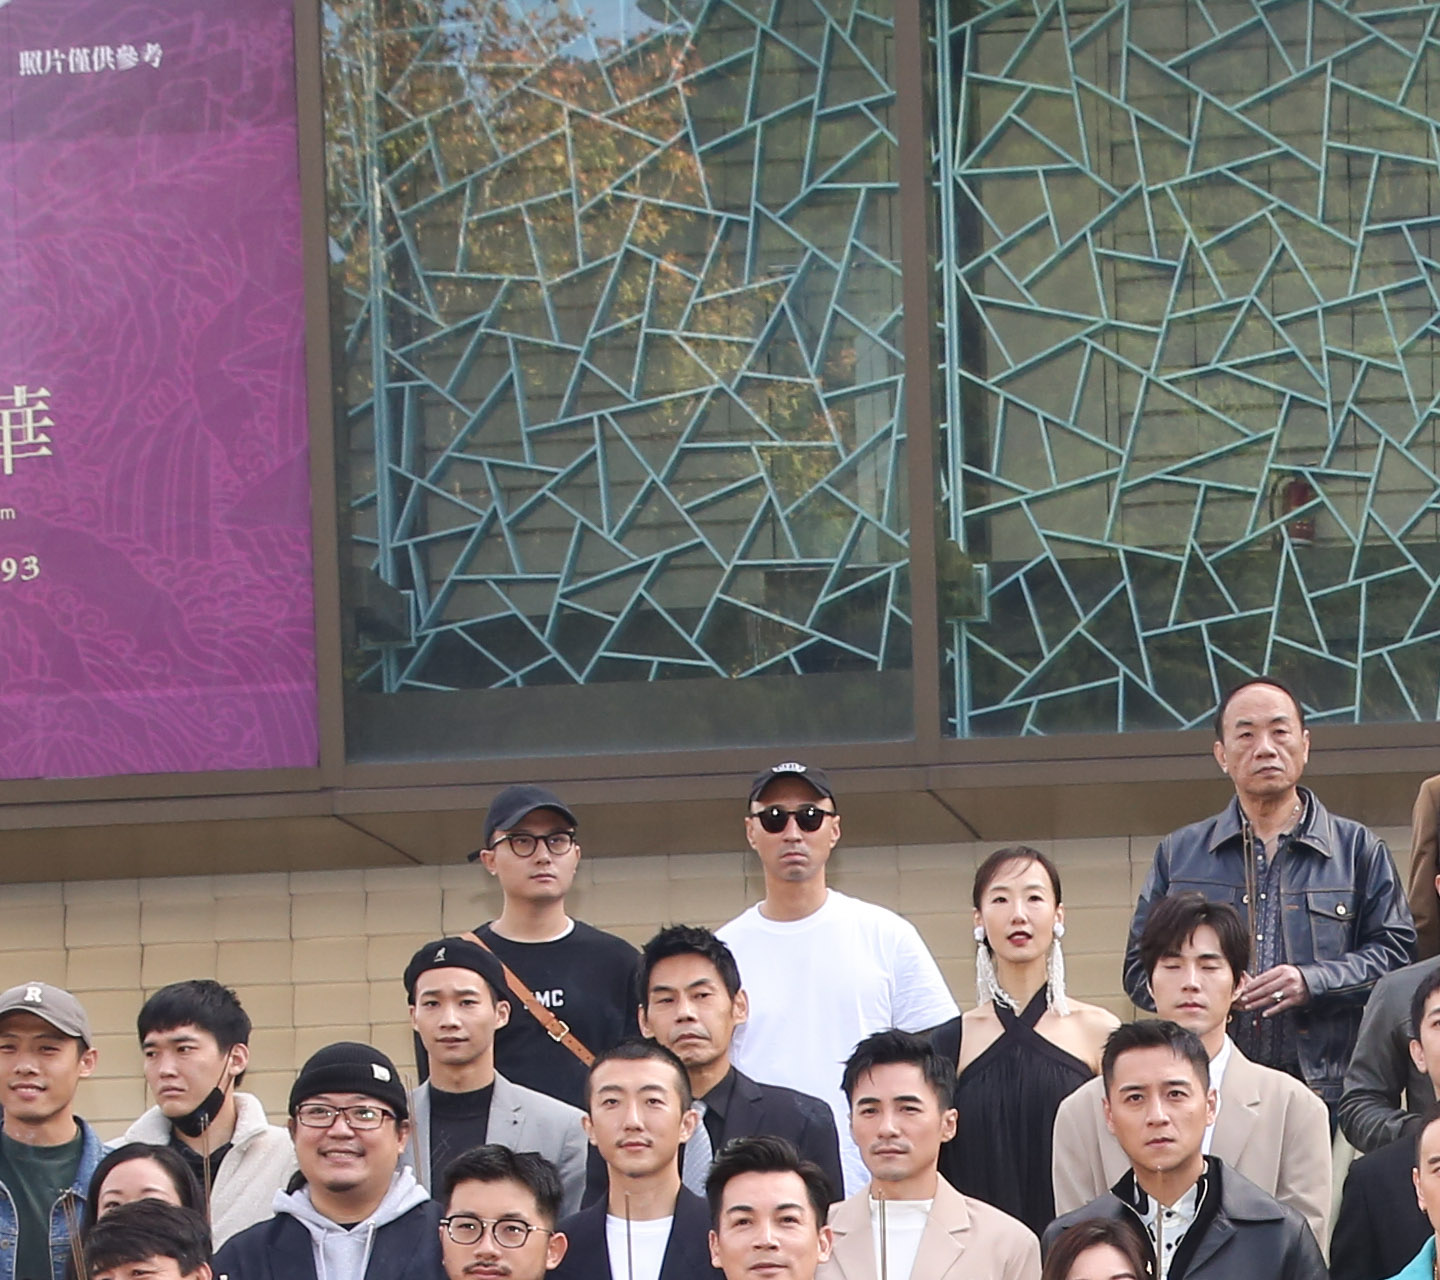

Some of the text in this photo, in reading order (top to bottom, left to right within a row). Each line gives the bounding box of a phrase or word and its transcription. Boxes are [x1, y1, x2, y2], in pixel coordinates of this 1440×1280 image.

[18, 43, 162, 77] 照片僅供參考
[24, 986, 42, 1003] R
